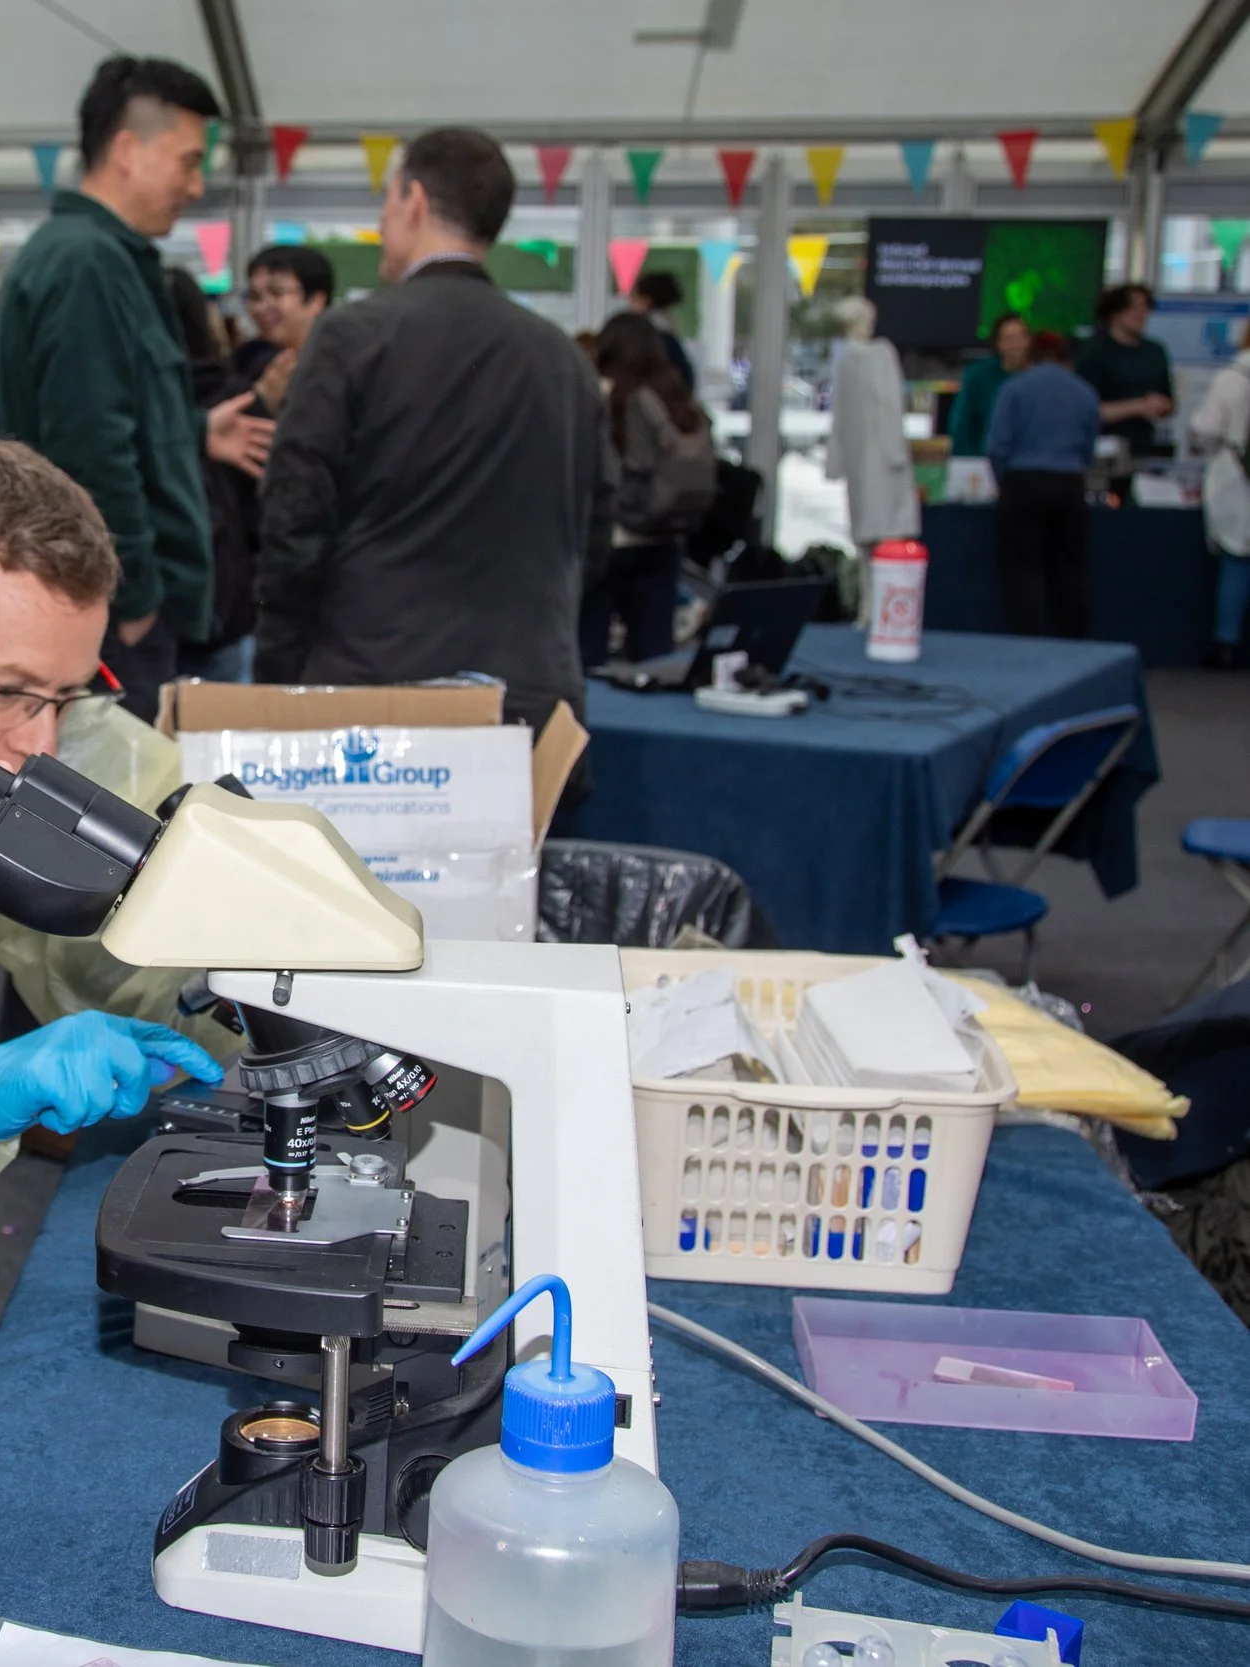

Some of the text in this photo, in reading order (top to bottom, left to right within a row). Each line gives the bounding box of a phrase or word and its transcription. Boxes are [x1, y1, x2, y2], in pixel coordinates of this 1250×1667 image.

[242, 761, 450, 790] Doggett Group
[313, 801, 451, 817] Communications
[387, 1067, 406, 1085] Nikon
[296, 1127, 303, 1136] E
